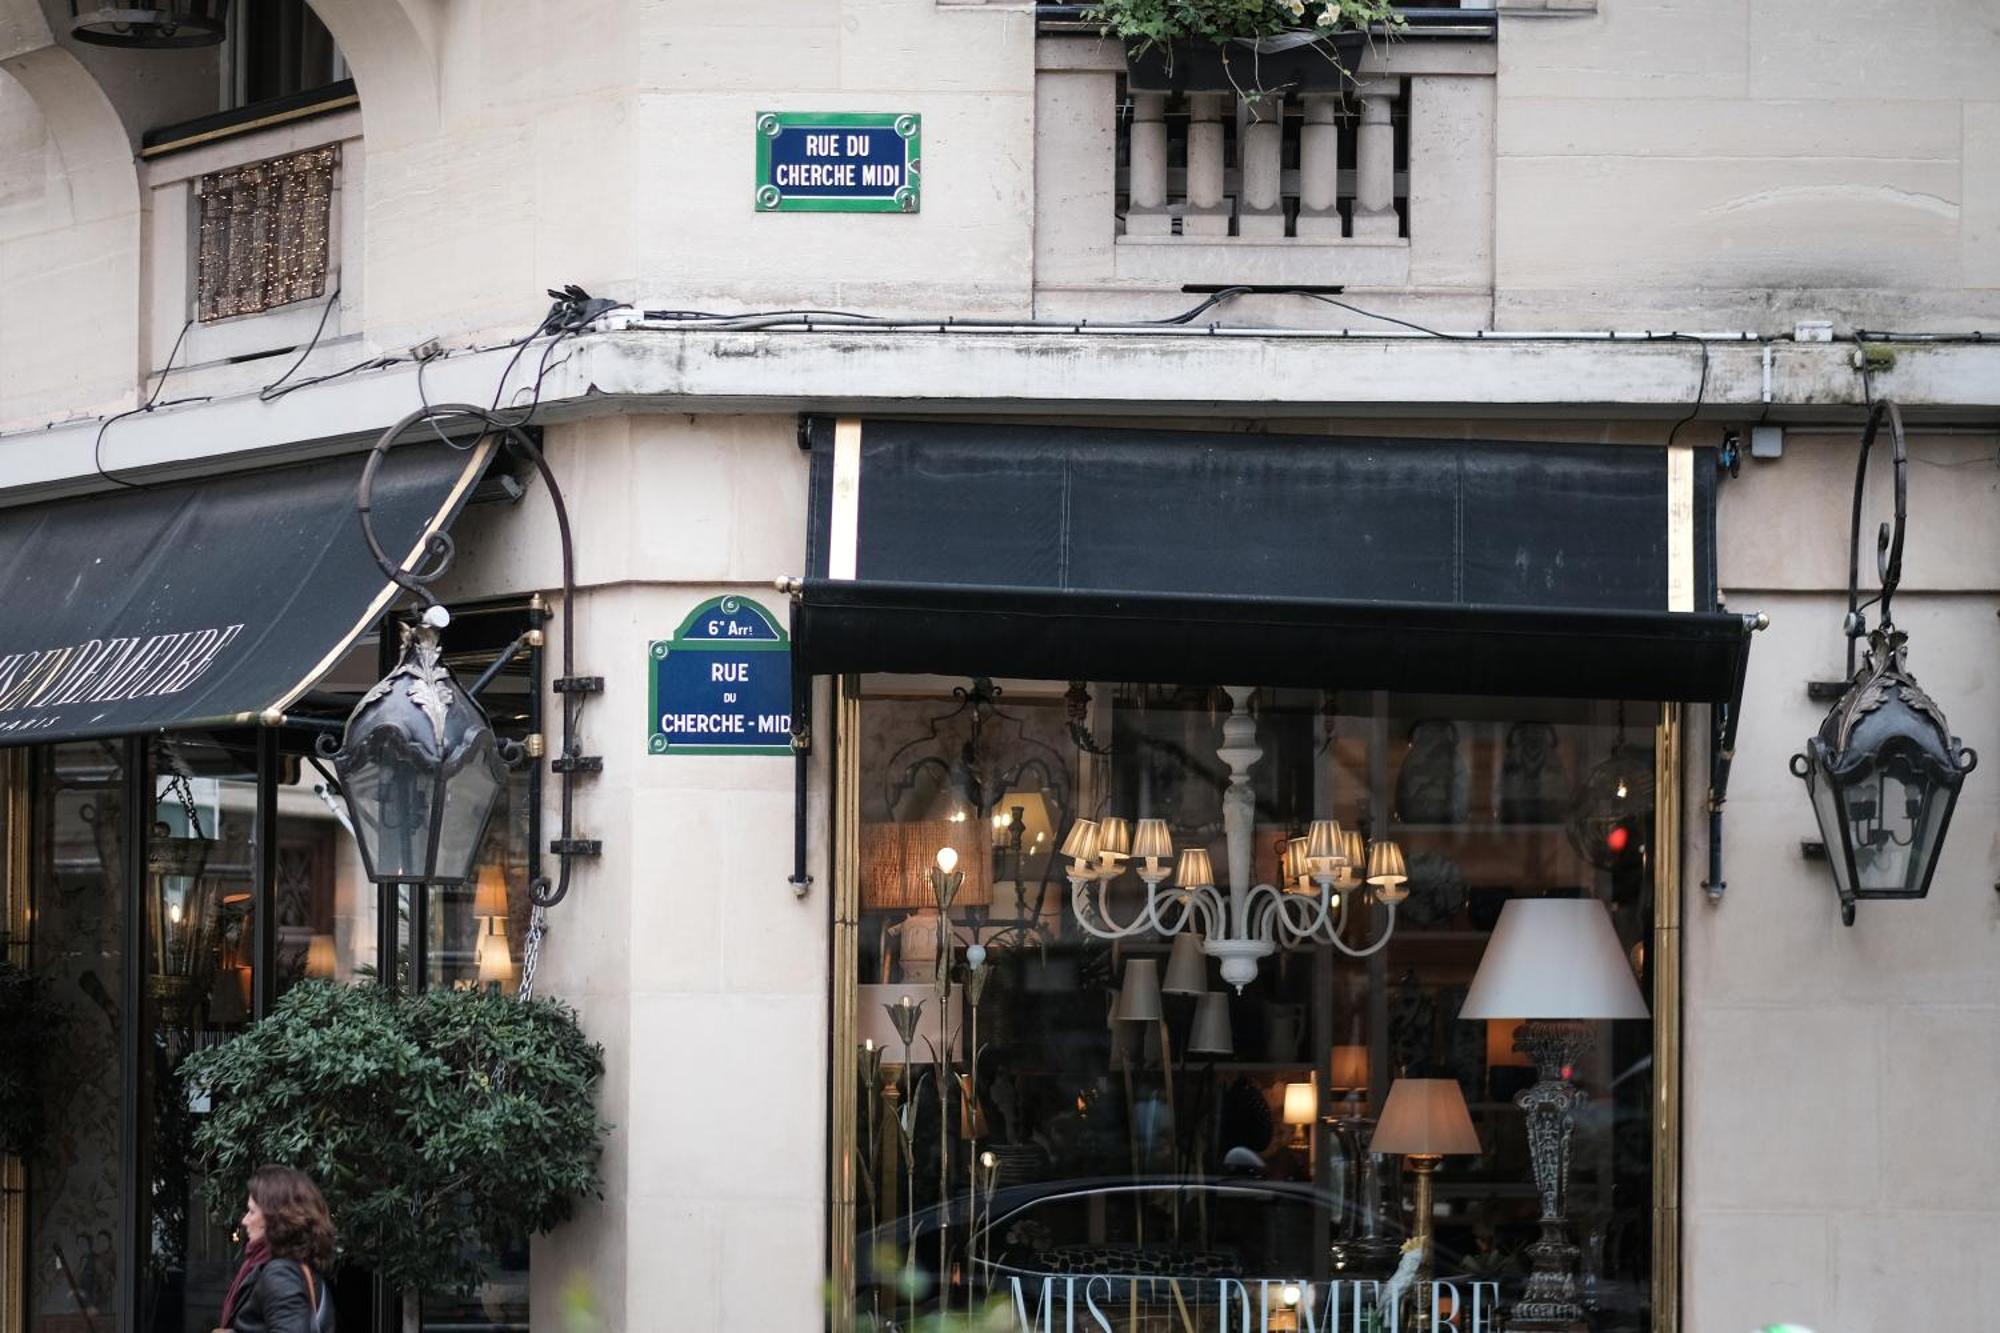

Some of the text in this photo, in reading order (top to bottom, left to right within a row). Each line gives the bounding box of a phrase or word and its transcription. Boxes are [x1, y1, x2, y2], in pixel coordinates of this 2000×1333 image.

[806, 135, 870, 157] RUE DU
[776, 164, 900, 187] CHERCHE MIDI
[711, 662, 749, 682] RUE
[723, 692, 737, 704] DU
